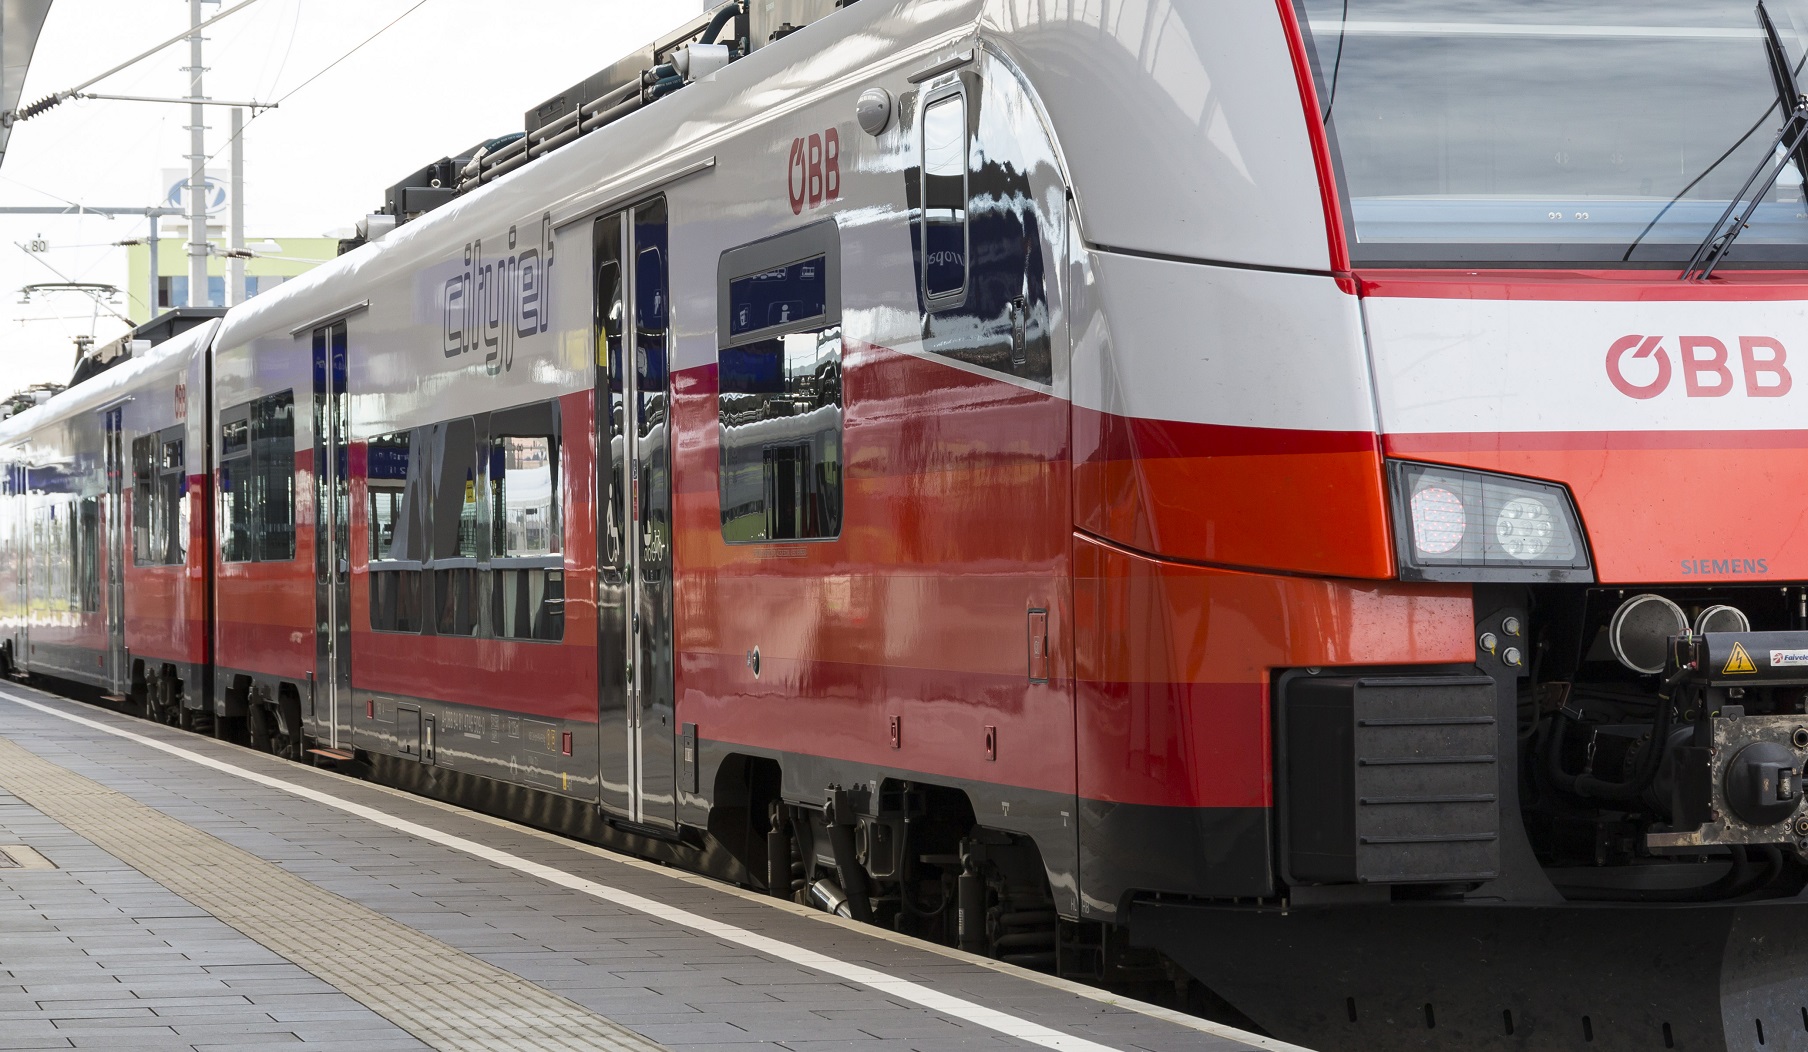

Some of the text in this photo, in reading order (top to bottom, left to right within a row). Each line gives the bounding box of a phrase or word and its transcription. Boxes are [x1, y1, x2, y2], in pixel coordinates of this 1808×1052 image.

[788, 127, 840, 215] ÖBB
[32, 241, 46, 252] 80
[444, 211, 555, 376] cityjet
[1606, 334, 1793, 400] ÖBB
[1681, 558, 1768, 575] SIEMENS
